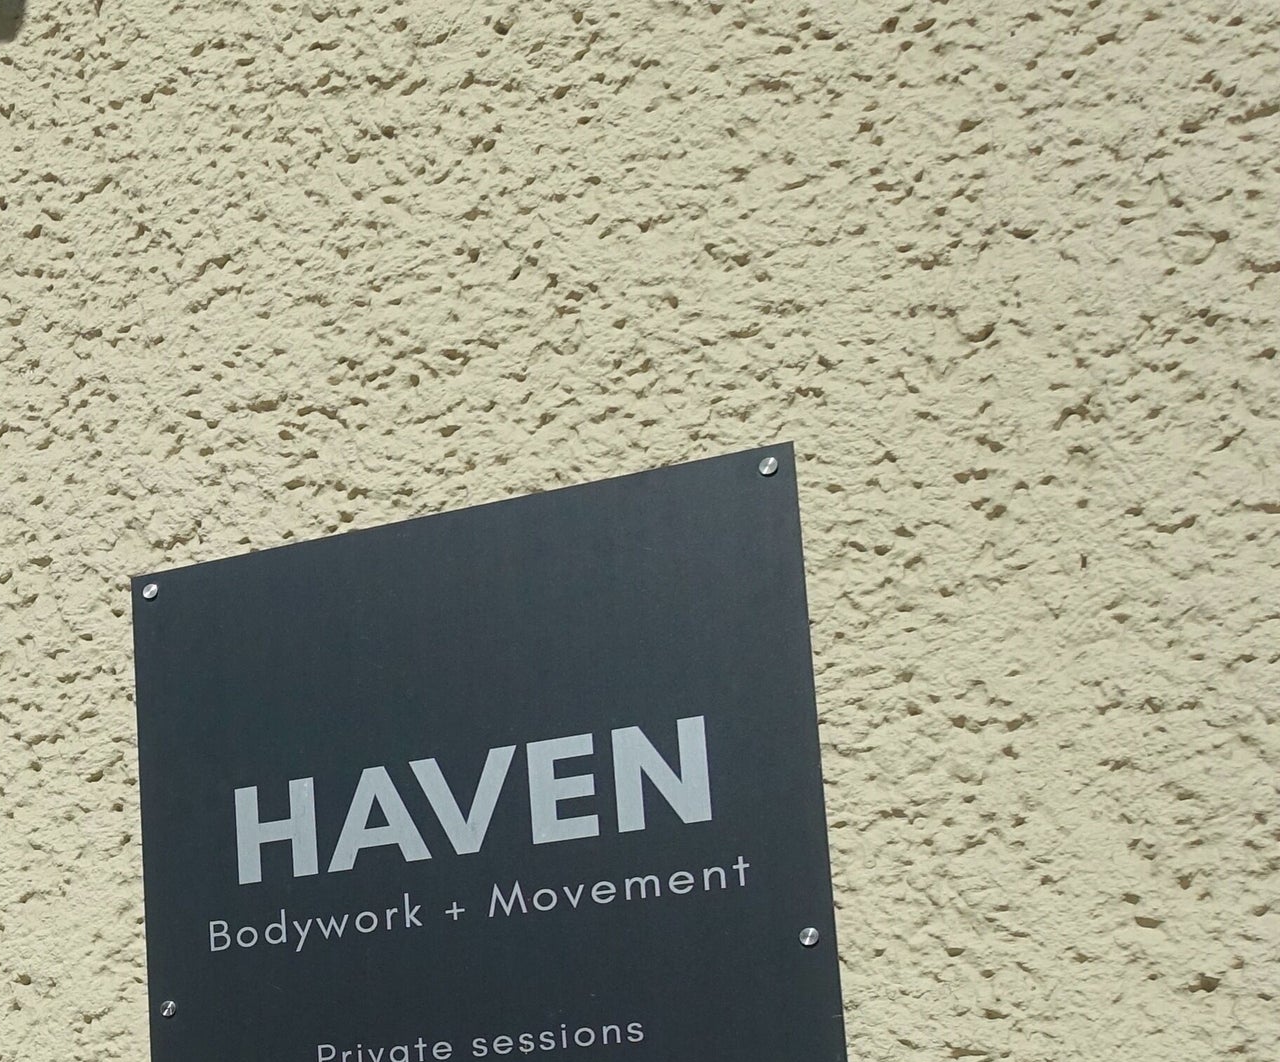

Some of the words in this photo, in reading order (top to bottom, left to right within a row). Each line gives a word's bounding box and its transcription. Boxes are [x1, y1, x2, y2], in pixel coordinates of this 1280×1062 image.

[235, 715, 713, 885] HAVEN
[209, 893, 423, 953] Bodywork
[444, 901, 466, 921] +
[488, 855, 750, 918] Movement
[472, 1020, 644, 1057] sessions
